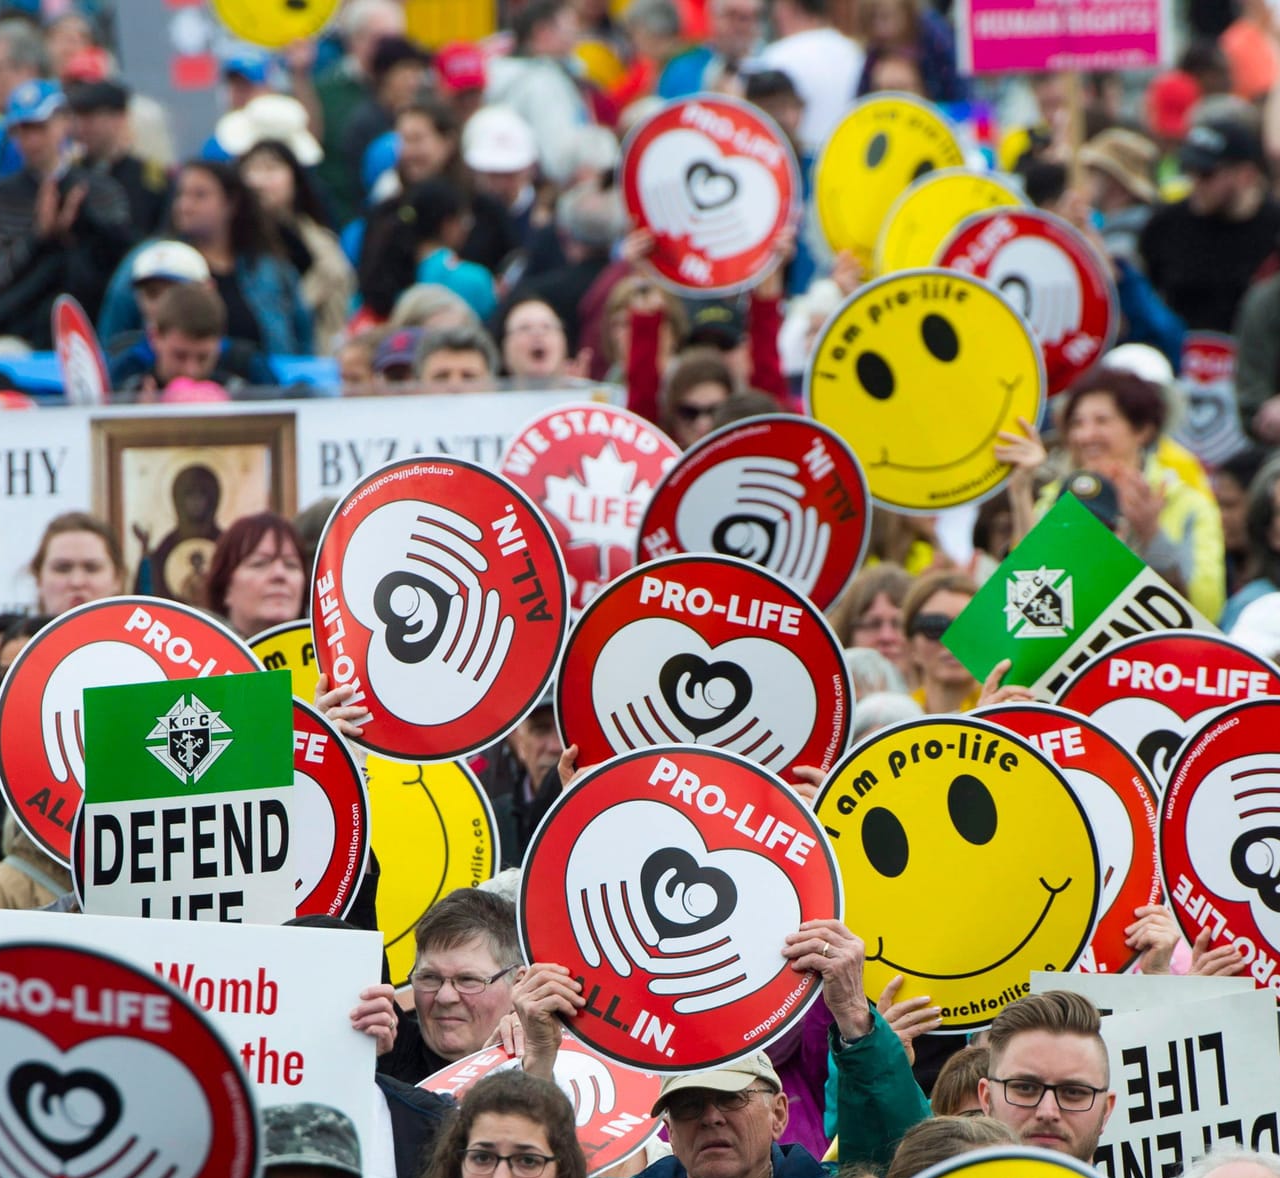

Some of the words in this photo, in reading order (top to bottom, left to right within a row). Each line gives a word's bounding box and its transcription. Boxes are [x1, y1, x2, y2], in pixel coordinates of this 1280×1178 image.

[832, 323, 862, 361] am
[867, 275, 969, 324] pro-life
[504, 428, 552, 478] WE
[547, 411, 660, 455] STAND
[341, 465, 455, 518] campaignlifecoalition.com
[570, 495, 641, 529] LIFE
[639, 575, 804, 637] PRO-LIFE
[1108, 658, 1271, 699] PRO-LIFE
[168, 716, 180, 730] K
[181, 717, 196, 728] OF
[199, 714, 210, 728] C
[836, 769, 880, 816] am
[887, 732, 1019, 779] pro-life
[1166, 716, 1240, 820] campaignlifecoalition.com
[92, 798, 290, 887] DEFEND
[648, 757, 817, 866] PRO-LIFE
[154, 962, 279, 1016] Womb
[241, 1037, 305, 1087] the
[1122, 1031, 1230, 1125] LIFE
